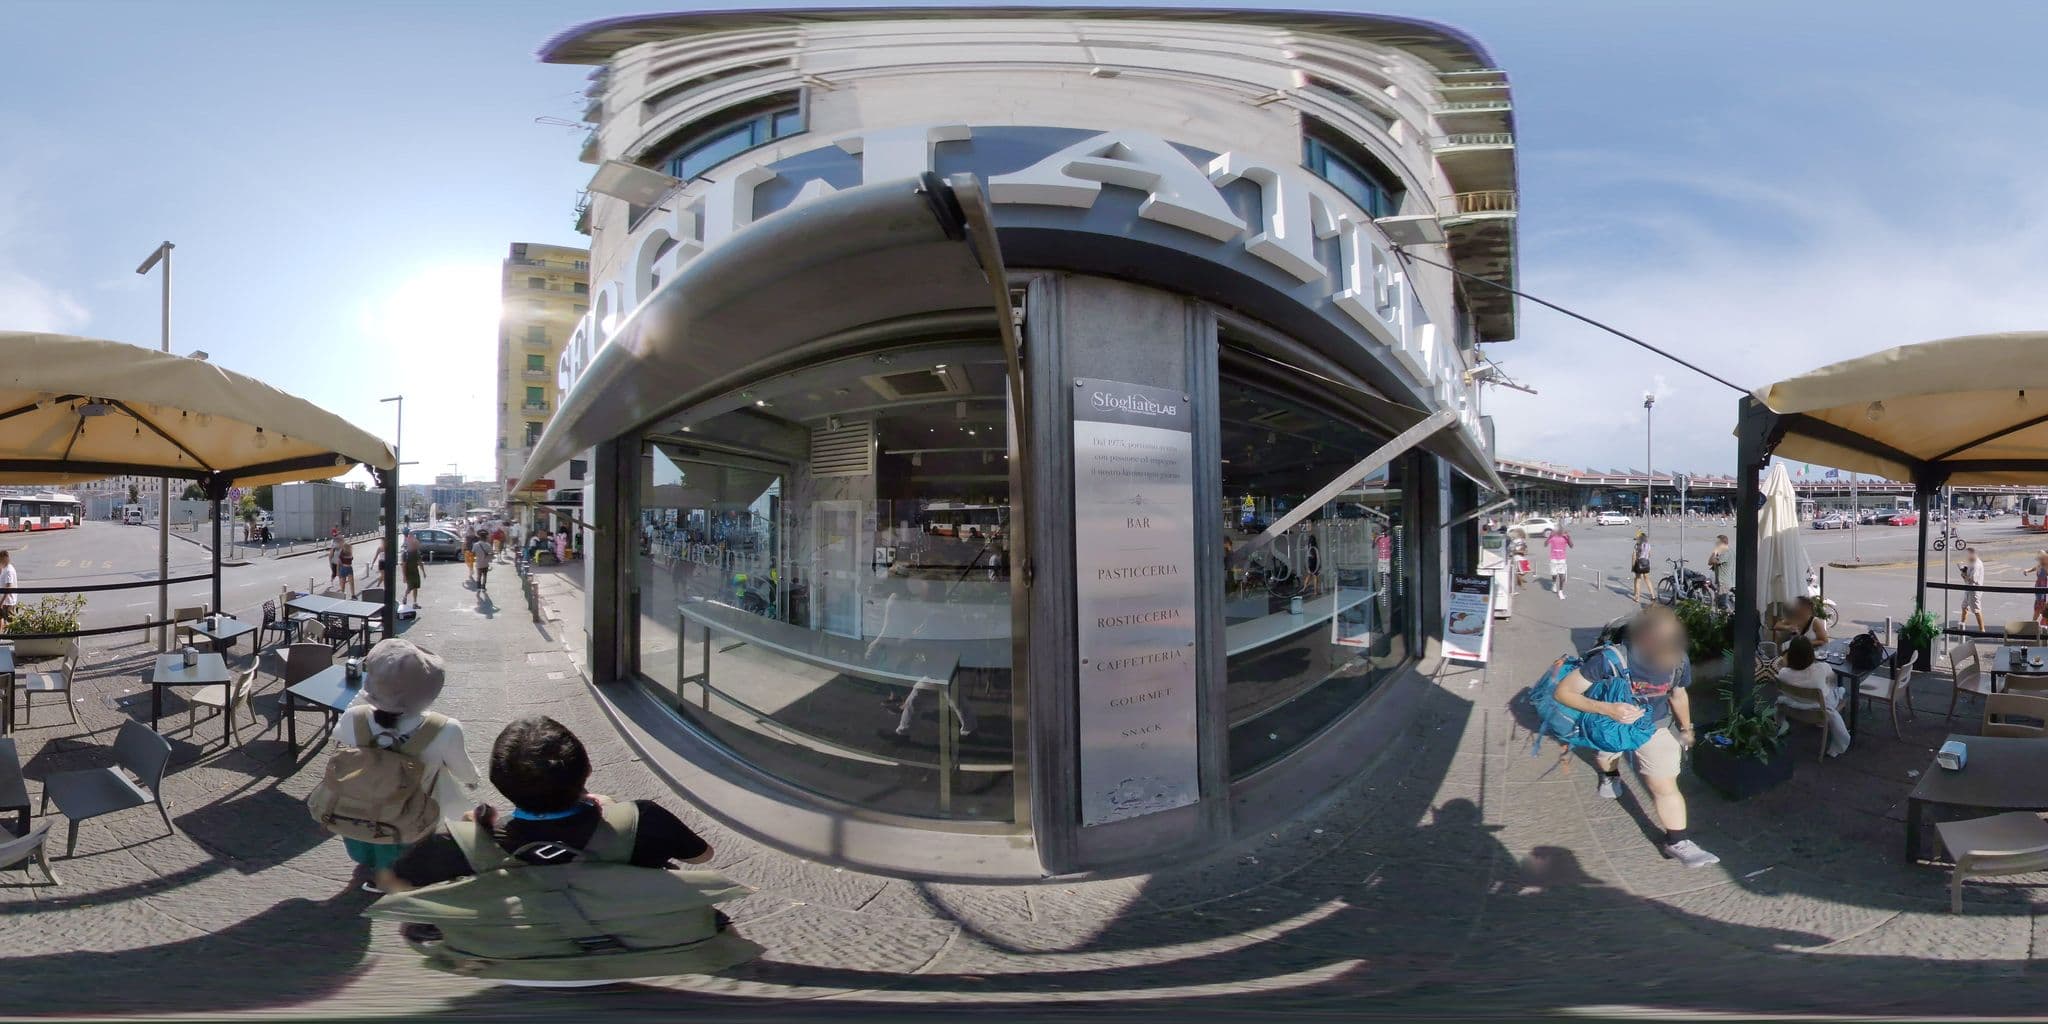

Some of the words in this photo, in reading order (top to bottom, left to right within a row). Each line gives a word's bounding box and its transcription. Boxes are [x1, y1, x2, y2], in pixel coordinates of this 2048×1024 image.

[1127, 518, 1151, 529] BAR
[1098, 564, 1178, 580] PASTICCERIA
[1098, 608, 1180, 628] ROSTICCERIA
[1097, 650, 1182, 672] CAFFETTERIA
[1110, 687, 1174, 708] GOURMET
[1121, 723, 1162, 738] SNACK
